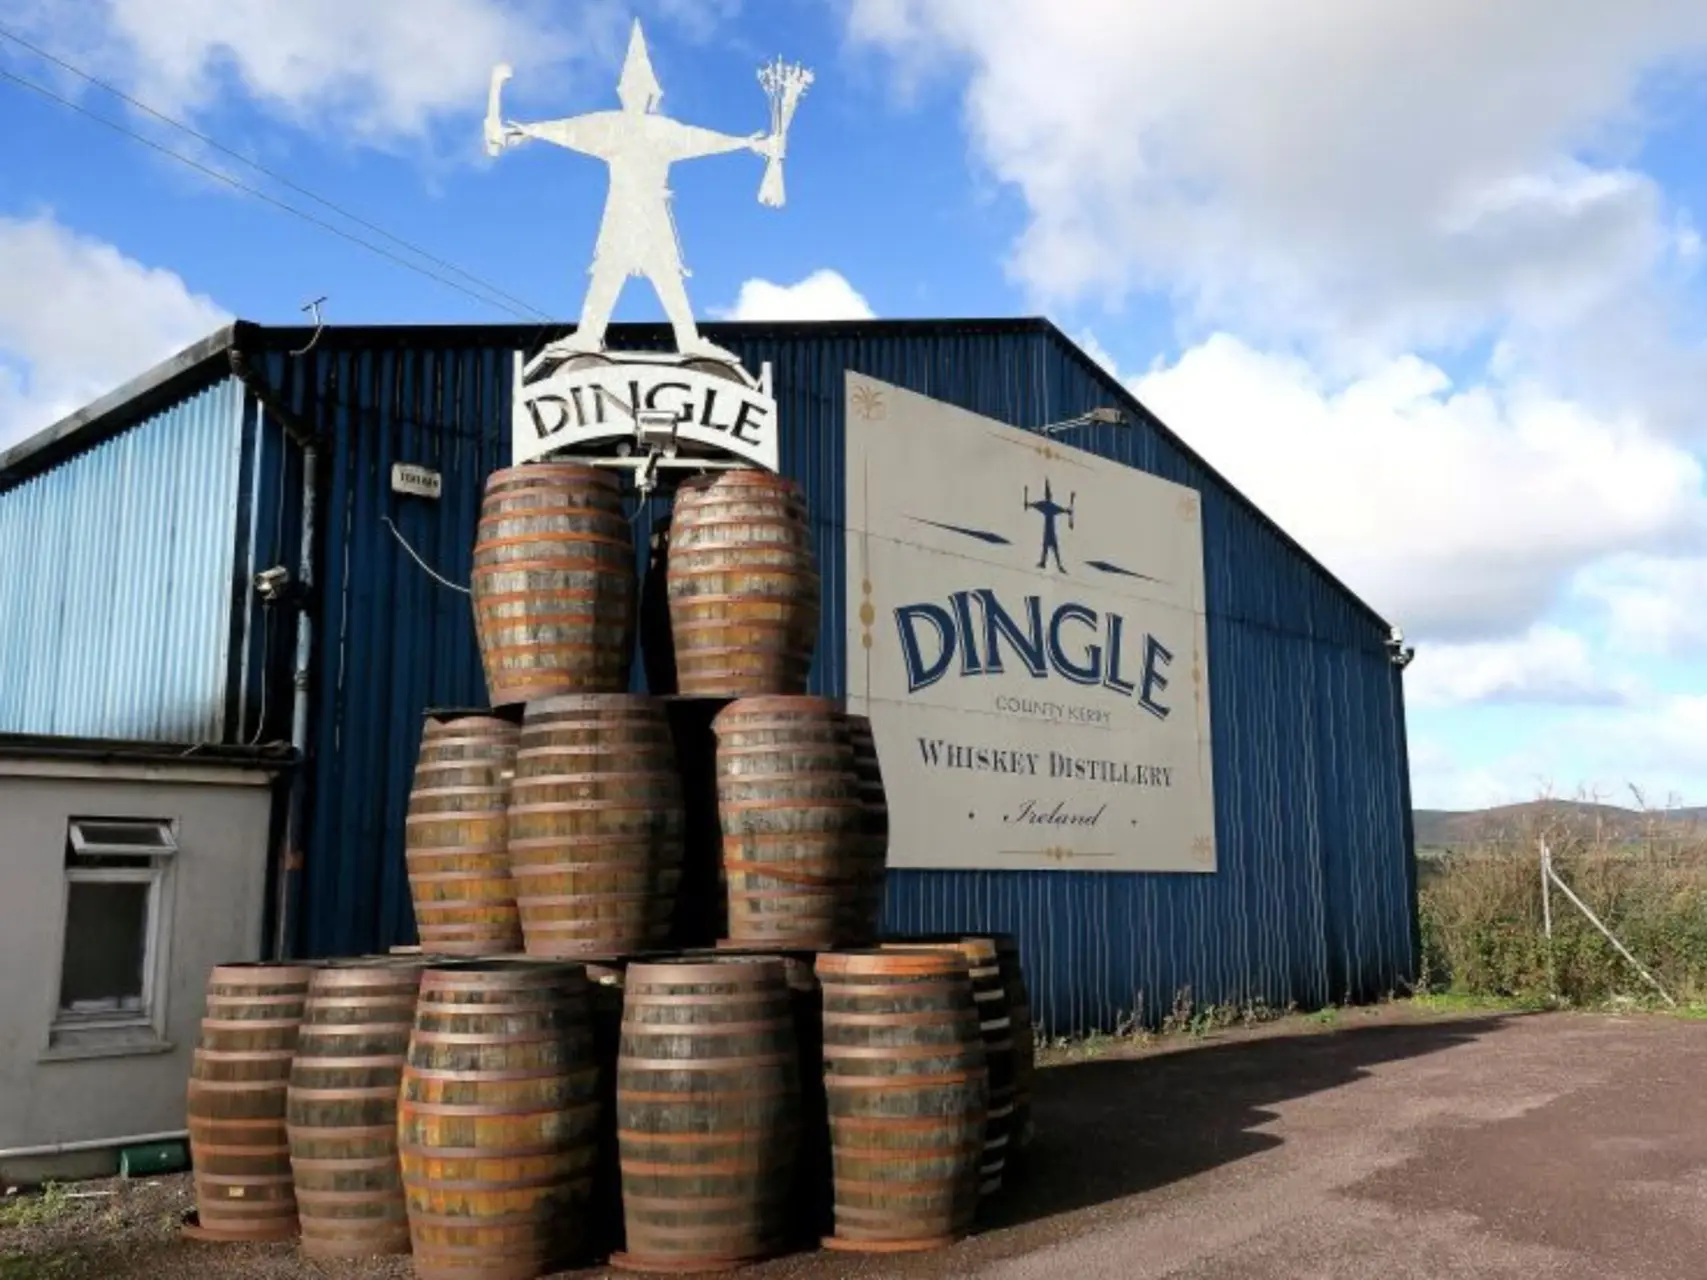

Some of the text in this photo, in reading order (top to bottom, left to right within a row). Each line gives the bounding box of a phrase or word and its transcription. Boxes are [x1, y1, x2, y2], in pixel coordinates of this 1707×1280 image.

[524, 380, 768, 446] DINGLE
[892, 588, 1175, 721] DINGLE
[995, 695, 1065, 718] COUNTY
[917, 736, 1174, 788] WHISKEY DISTILLERY
[1002, 799, 1108, 828] Ireland
